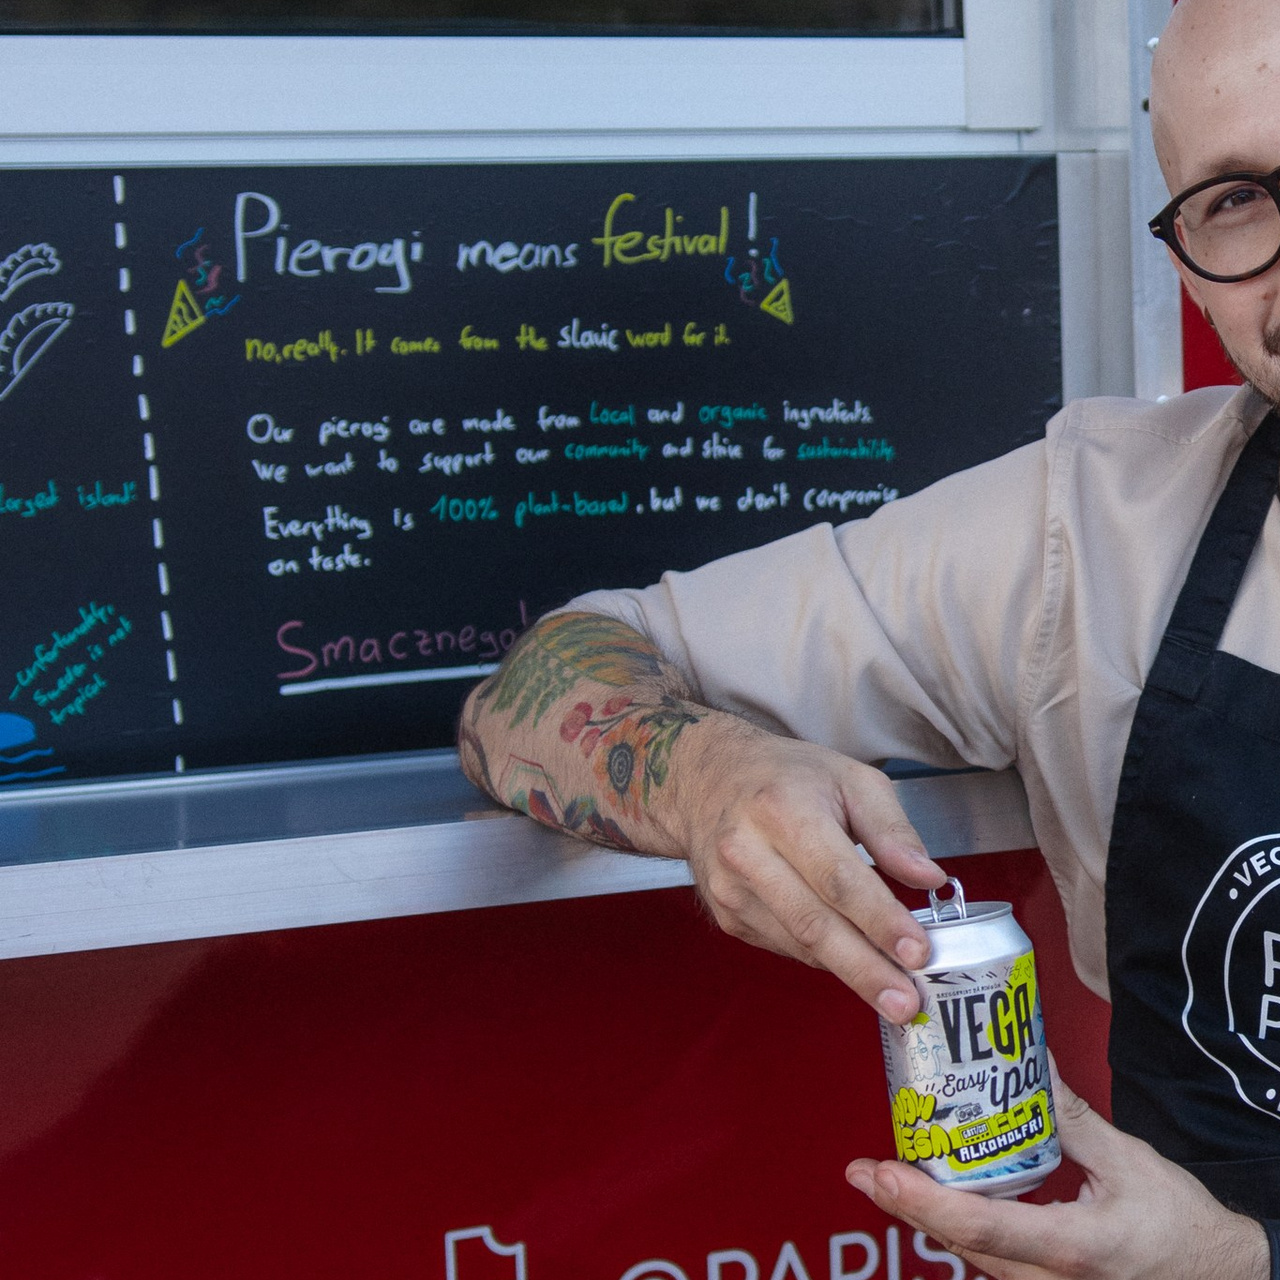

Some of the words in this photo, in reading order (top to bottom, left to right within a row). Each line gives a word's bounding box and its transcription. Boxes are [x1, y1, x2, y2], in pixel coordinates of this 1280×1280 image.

[457, 238, 578, 272] means
[515, 323, 549, 351] the
[625, 322, 672, 347] word
[247, 413, 295, 444] Our
[646, 401, 685, 424] and
[262, 505, 373, 541] Everything
[430, 494, 499, 522] 100%
[937, 981, 1036, 1064] VEGA
[941, 1069, 990, 1098] Easy
[958, 1115, 1044, 1163] ALKOHOLFRI
